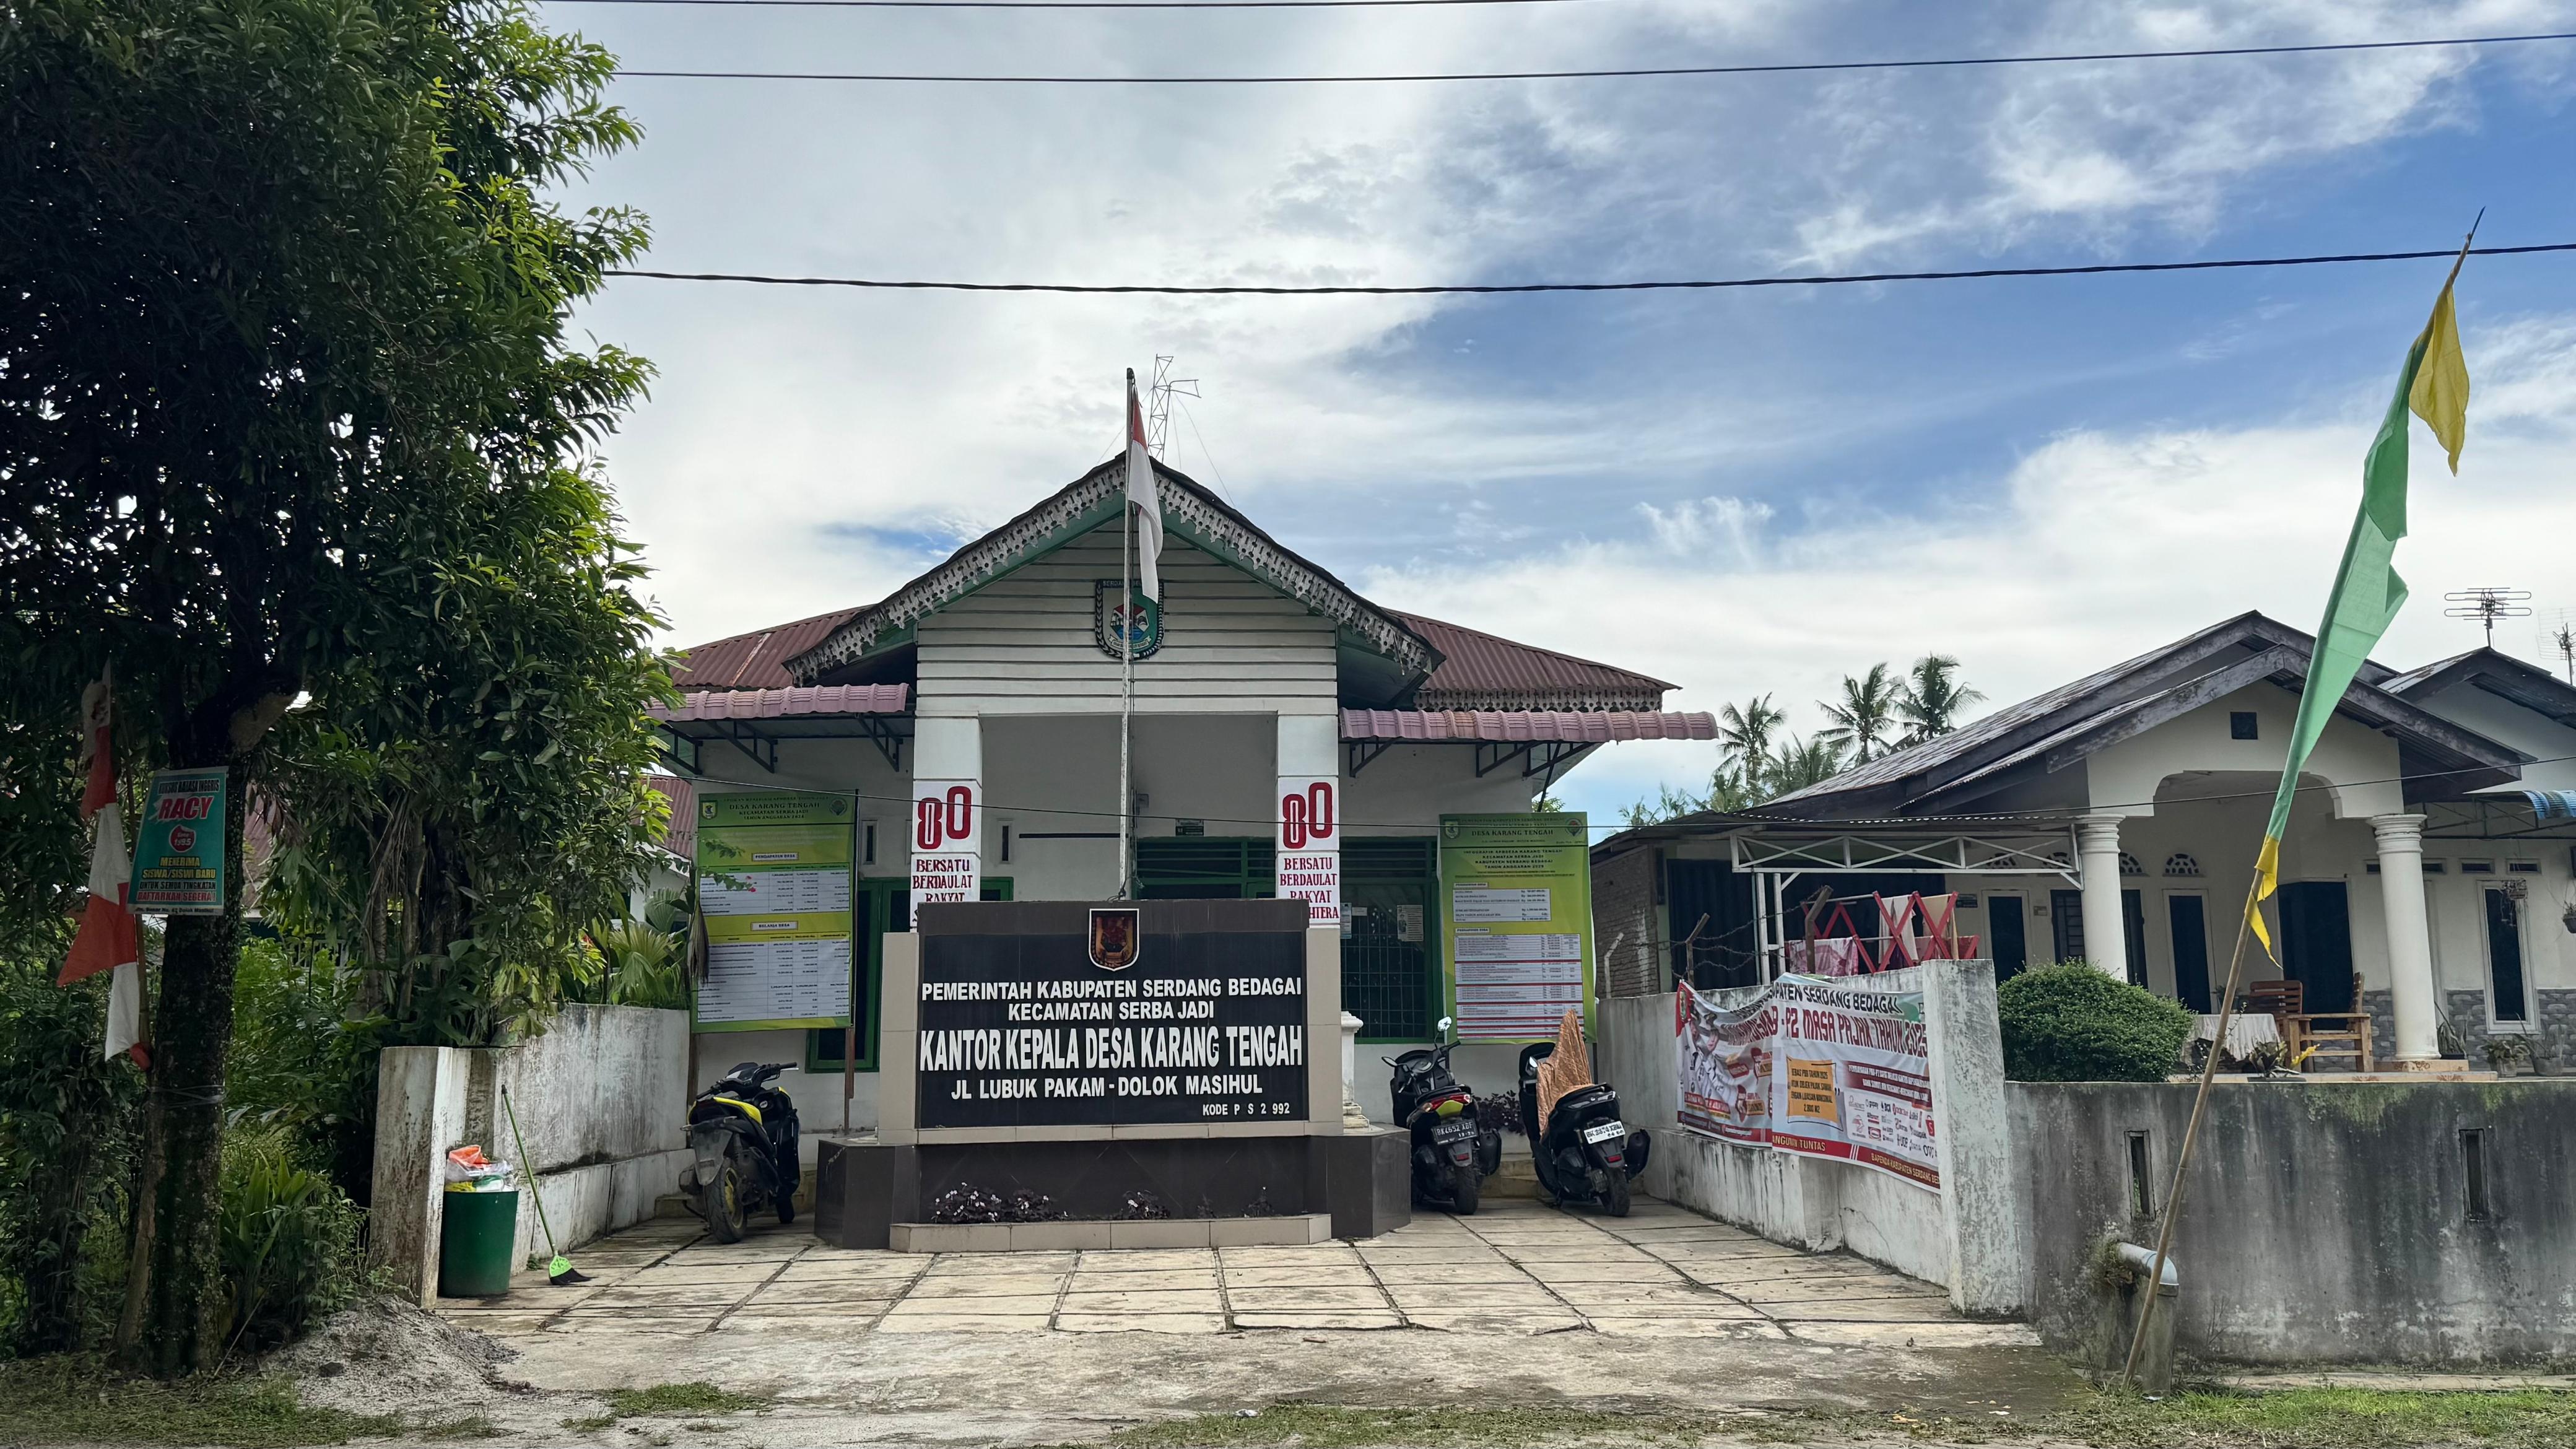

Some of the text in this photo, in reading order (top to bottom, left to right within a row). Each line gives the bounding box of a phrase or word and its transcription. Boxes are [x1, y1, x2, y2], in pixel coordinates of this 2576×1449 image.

[158, 796, 214, 820] RACY
[1282, 781, 1333, 849] 80
[917, 786, 972, 850] 80
[160, 857, 200, 866] MENERIMA
[916, 859, 970, 872] BERSATU
[1284, 857, 1332, 871] BERSATU
[195, 869, 215, 878] BARU
[1280, 873, 1337, 886] BERDAULAT
[912, 875, 973, 889] BERDAULAT
[925, 893, 965, 902] RAKYAT
[1290, 890, 1332, 903] RAKYAT
[1309, 907, 1339, 919] HTERA
[923, 978, 1300, 1000] PEMERINTAH KABUPATEN SERDANG BEDAGAI
[1803, 986, 1851, 1009] SERDANG
[1853, 994, 1903, 1014] BEDAGAI
[1009, 1001, 1213, 1020] KECAMATAN SERBA JADI
[1803, 1009, 1837, 1042] MASA
[1837, 1013, 1874, 1048] PAJAK
[1873, 1017, 1907, 1053] TAHUN
[1905, 1022, 1928, 1058] 2025
[920, 1025, 1302, 1071] KANTOR KEPALA DESA KARANG TENGAH
[951, 1080, 972, 1099] JL
[980, 1079, 1037, 1099] LUBUK
[1045, 1077, 1104, 1097] PAKAM
[1118, 1076, 1177, 1096] DOLOK
[1186, 1074, 1262, 1094] MASIHUL
[1203, 1103, 1290, 1115] KODE P S 2 992
[1799, 1139, 1826, 1152] TUNTAS
[1871, 1152, 1891, 1167] BAPENDA
[1890, 1158, 1912, 1174] KABUPATEN
[1912, 1165, 1931, 1181] SERDANG
